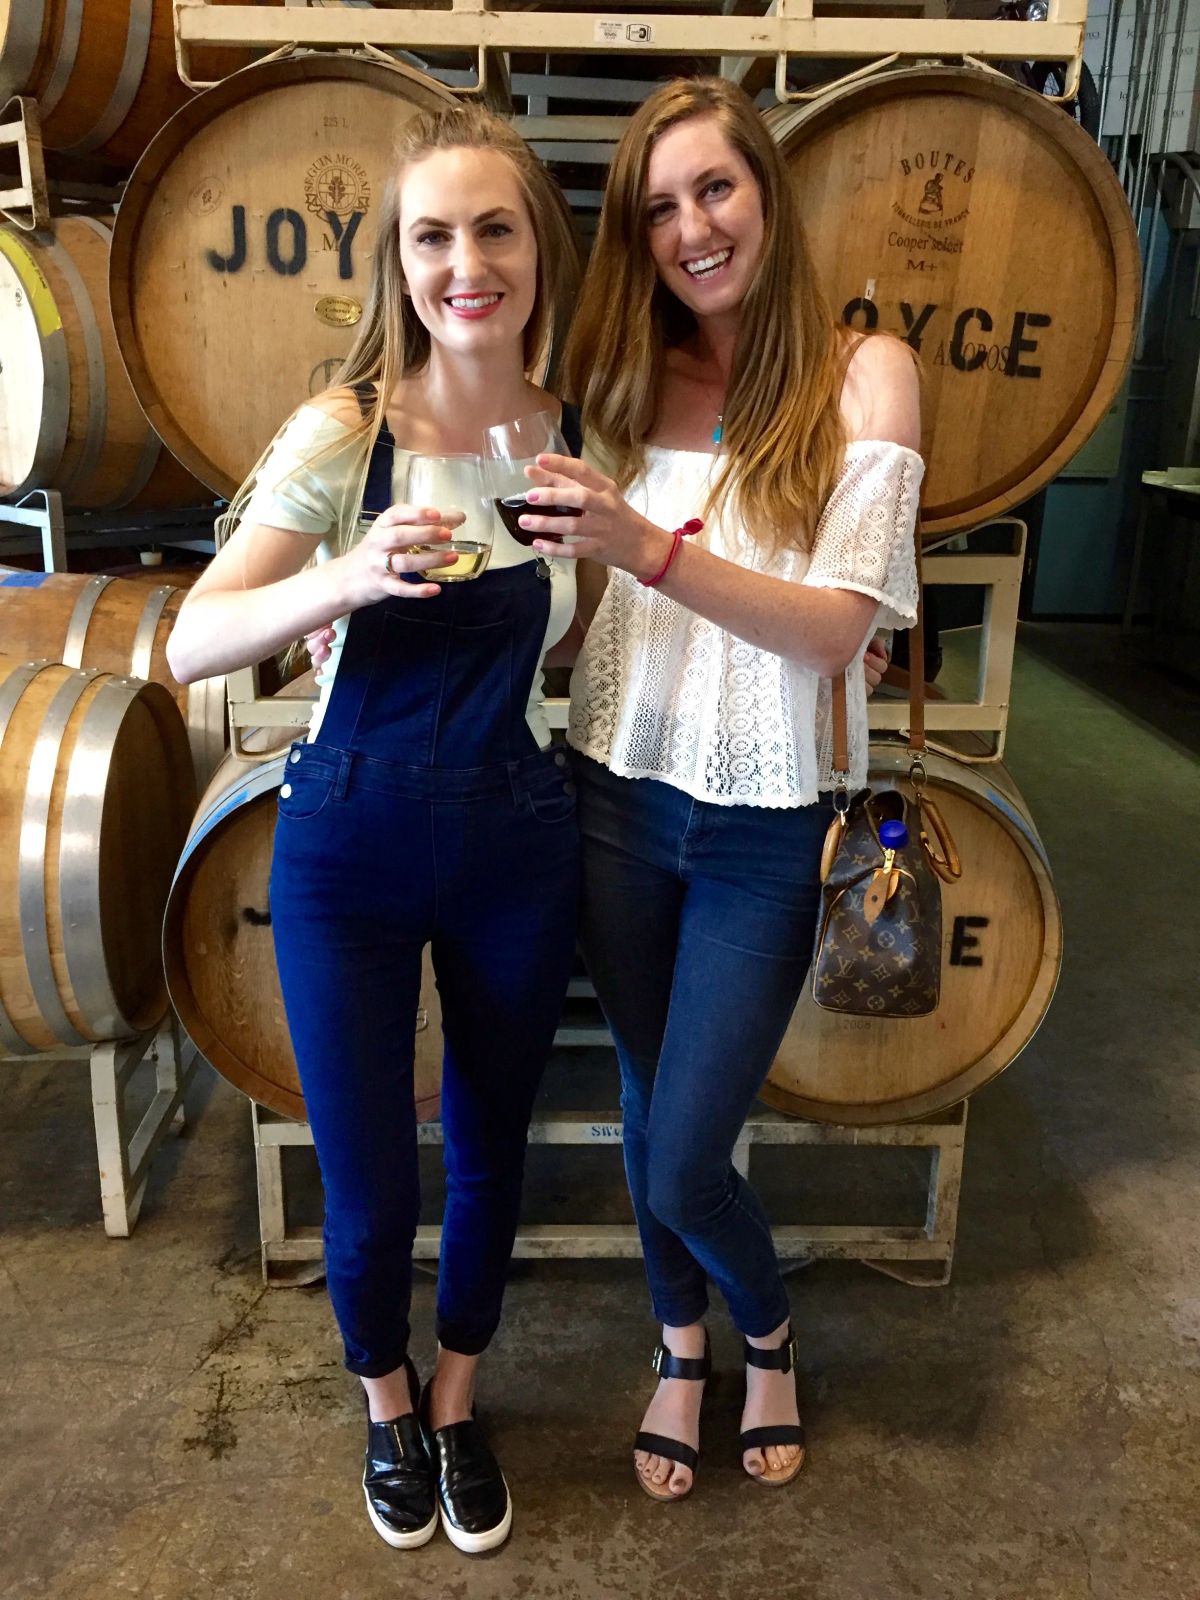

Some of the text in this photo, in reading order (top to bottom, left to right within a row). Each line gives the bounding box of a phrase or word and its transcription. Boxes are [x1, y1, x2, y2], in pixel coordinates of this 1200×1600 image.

[304, 153, 371, 196] SEGUIN MOREAU
[901, 151, 975, 183] BOUTES
[207, 205, 363, 279] JOY
[906, 259, 937, 272] M+
[950, 917, 988, 966] E
